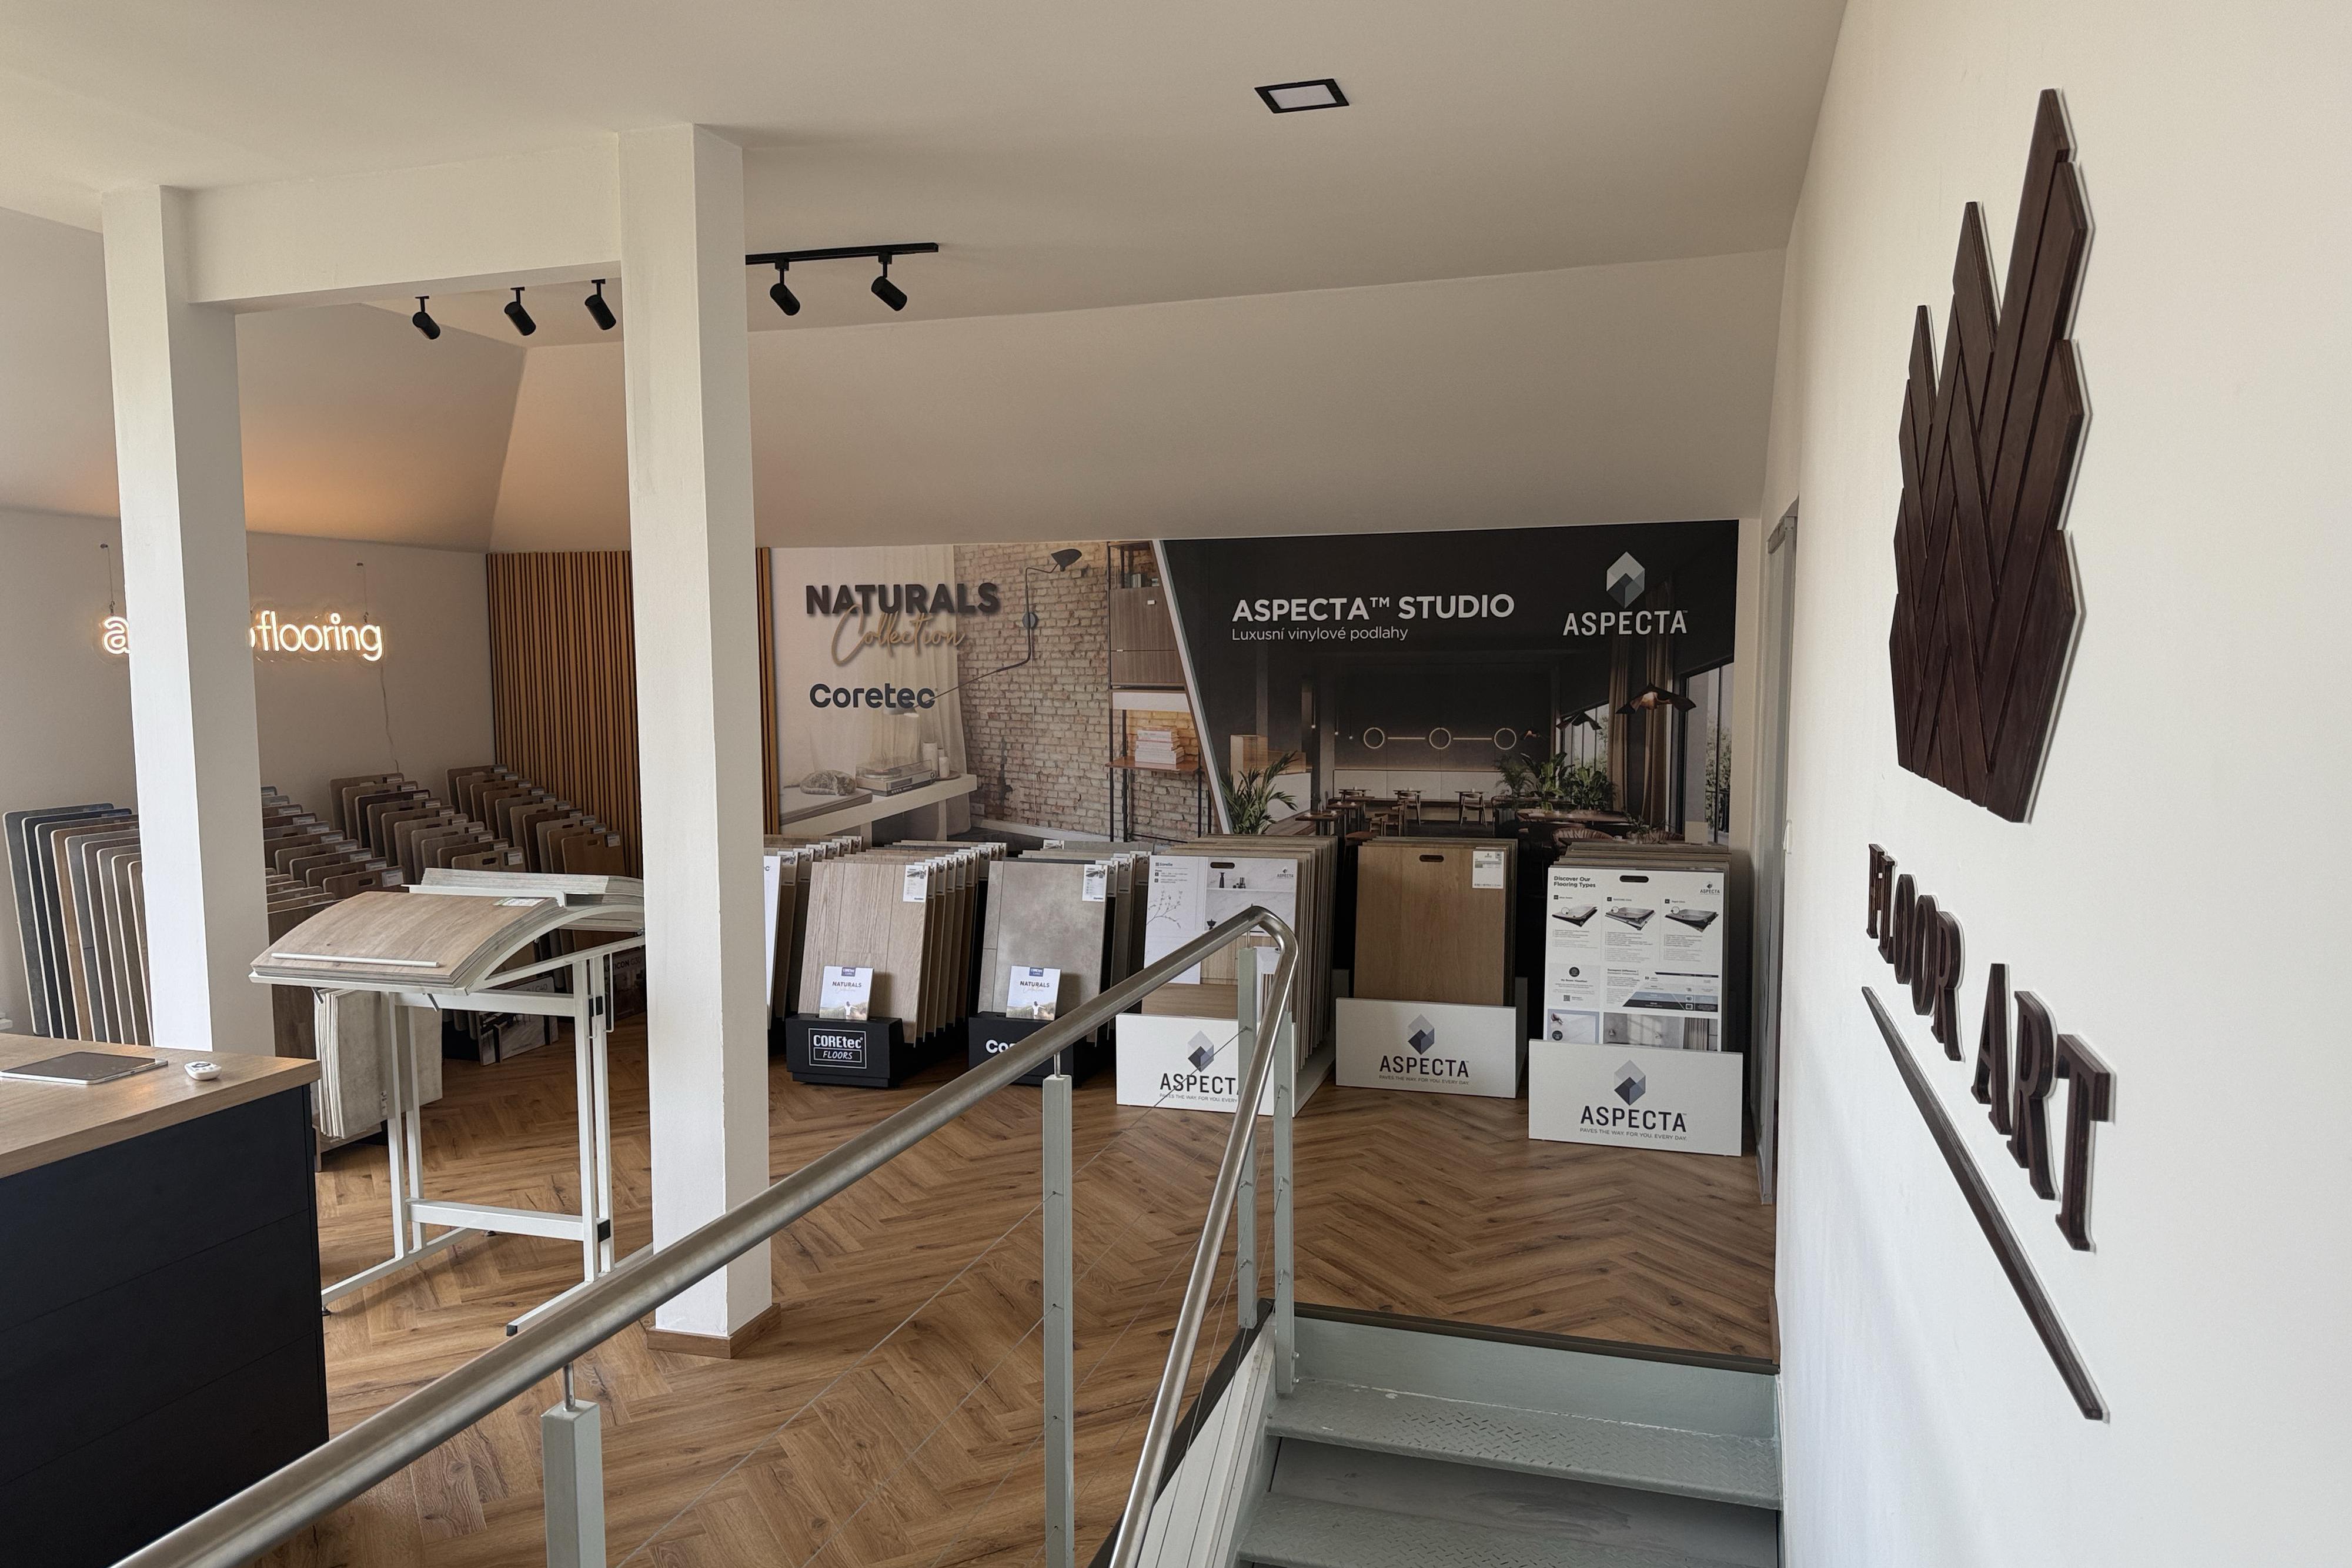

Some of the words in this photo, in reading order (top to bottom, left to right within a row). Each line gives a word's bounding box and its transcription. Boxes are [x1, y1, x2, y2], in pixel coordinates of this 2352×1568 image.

[806, 582, 999, 614] NATURALS
[1398, 593, 1515, 620] STUDIO
[250, 610, 382, 661] flooring
[831, 603, 965, 665] Collection
[1232, 627, 1285, 640] Luxusní
[1288, 627, 1346, 642] vinylové
[1350, 626, 1408, 641] podlahy
[810, 683, 935, 709] Coretec
[813, 1035, 862, 1049] COREtec
[823, 1050, 853, 1059] FLOORS
[985, 1039, 1016, 1054] Co
[1866, 843, 1964, 1062] FLOOR
[1970, 962, 2112, 1252] ART
[1160, 1072, 1238, 1095] ASPECT
